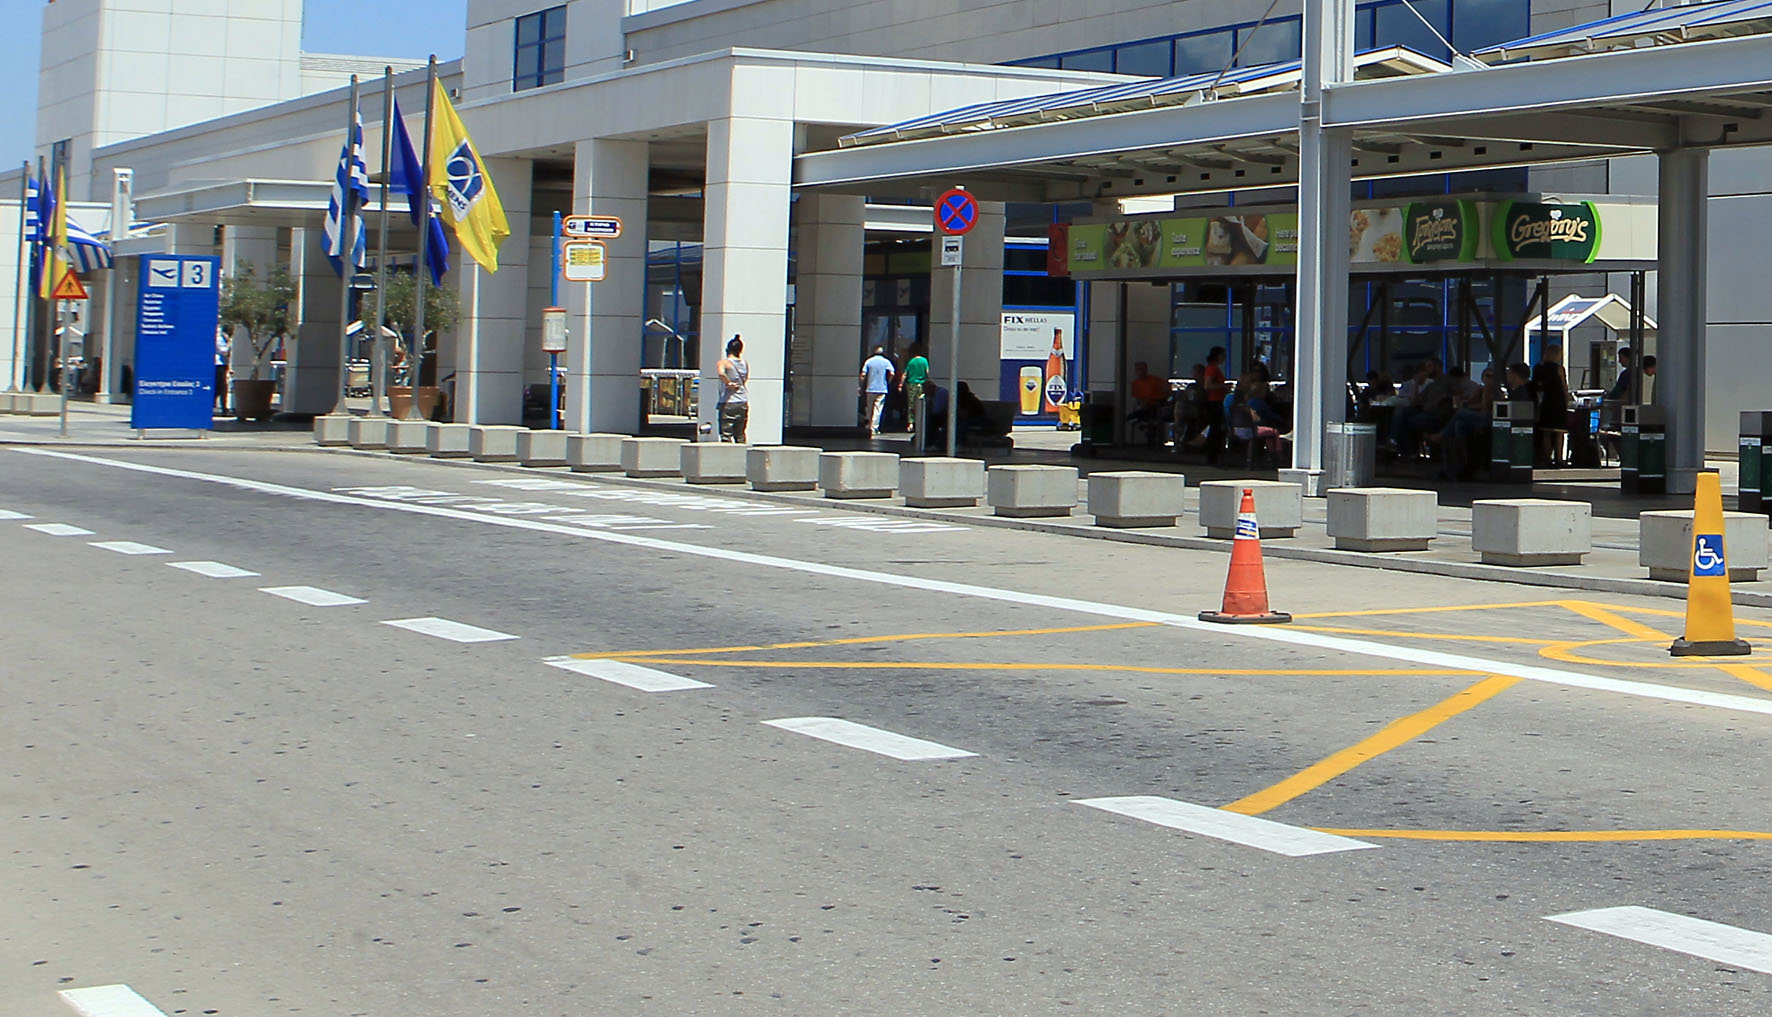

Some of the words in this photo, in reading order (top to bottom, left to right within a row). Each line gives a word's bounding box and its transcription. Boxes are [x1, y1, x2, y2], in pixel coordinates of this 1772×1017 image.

[1511, 214, 1589, 252] Gregory's
[191, 264, 204, 285] 3
[1004, 316, 1024, 324] FIX
